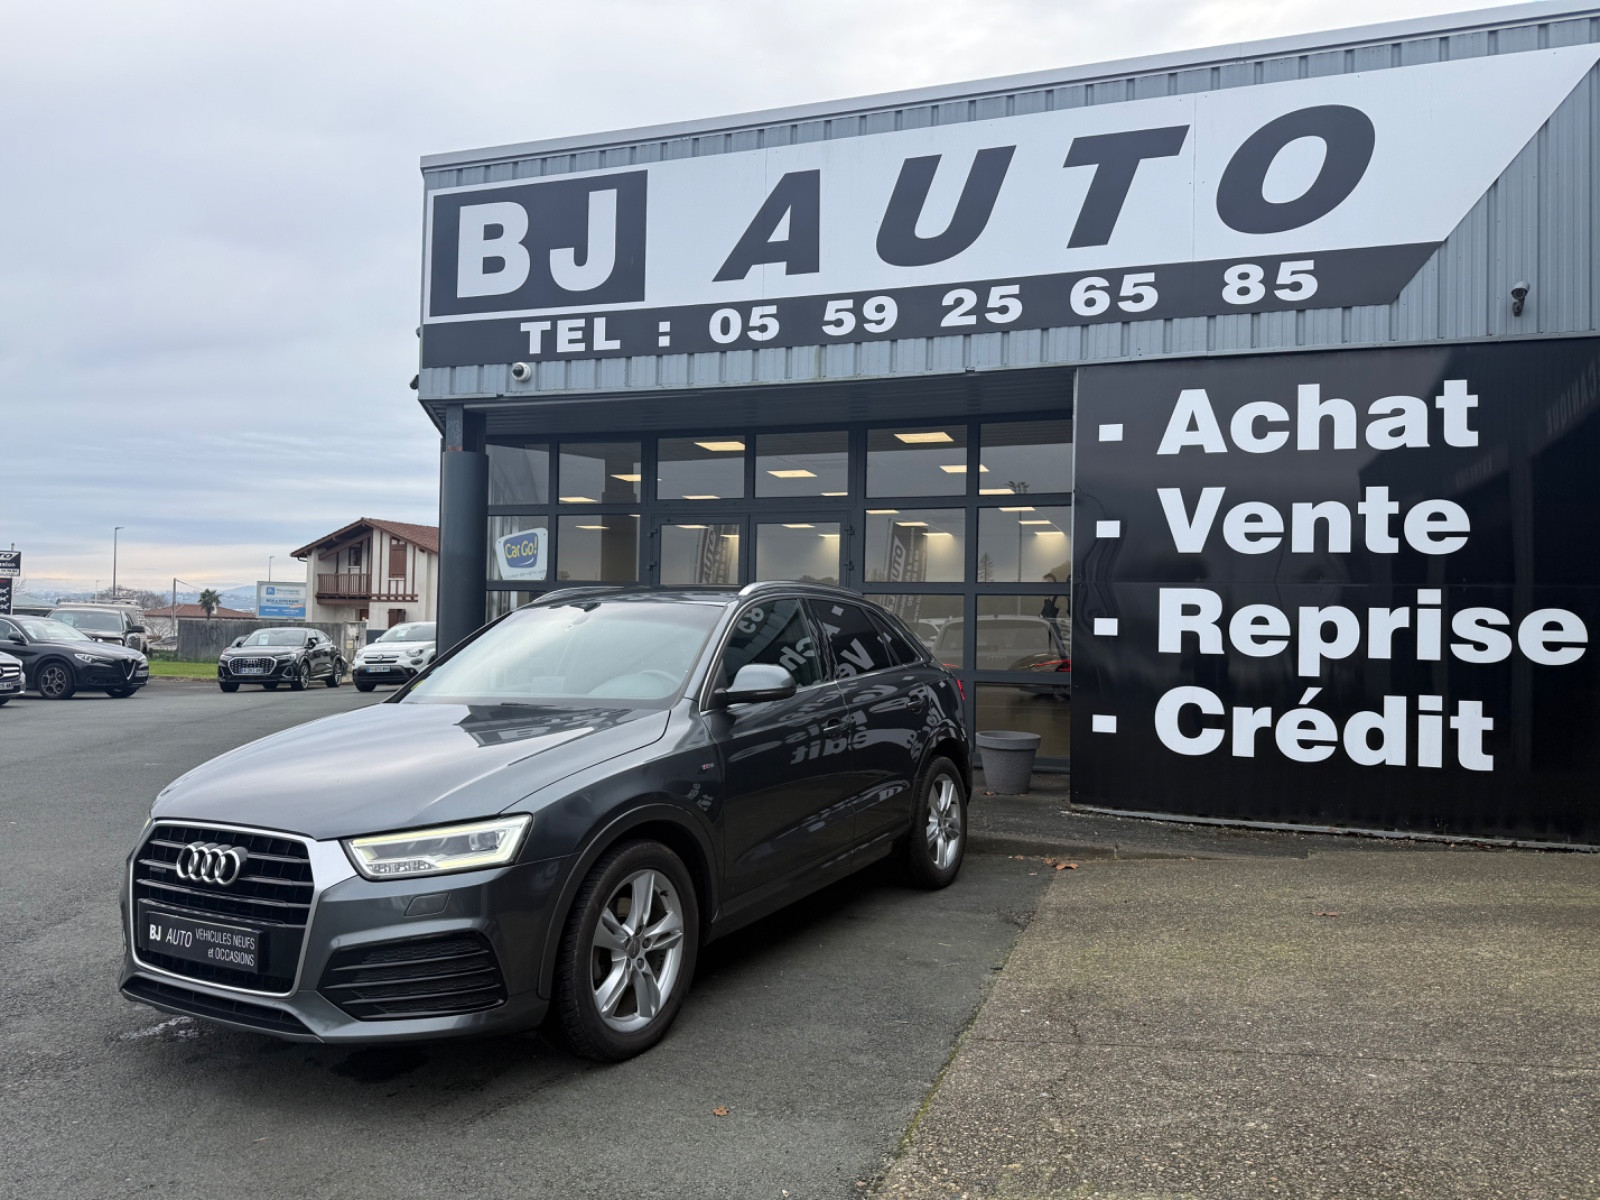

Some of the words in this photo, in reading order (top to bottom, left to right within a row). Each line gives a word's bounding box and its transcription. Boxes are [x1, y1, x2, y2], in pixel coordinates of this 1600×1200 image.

[457, 188, 617, 298] BJ
[711, 104, 1375, 282] AUTO
[520, 317, 621, 354] TEL
[708, 305, 780, 344] 05
[822, 295, 898, 336] 59
[940, 285, 1023, 327] 25
[1069, 271, 1159, 316] 65
[1221, 260, 1319, 305] 85
[1156, 379, 1479, 455] Achat
[1156, 486, 1471, 555] Vente
[891, 544, 903, 582] UTO
[1158, 587, 1589, 677] Reprise
[1154, 685, 1495, 772] Crédit
[149, 924, 162, 941] BJ
[166, 928, 193, 948] AUTO
[195, 928, 232, 946] VEHICULES
[232, 935, 255, 950] NEUFS
[207, 948, 214, 959] et
[214, 948, 255, 967] OCCASIONS
